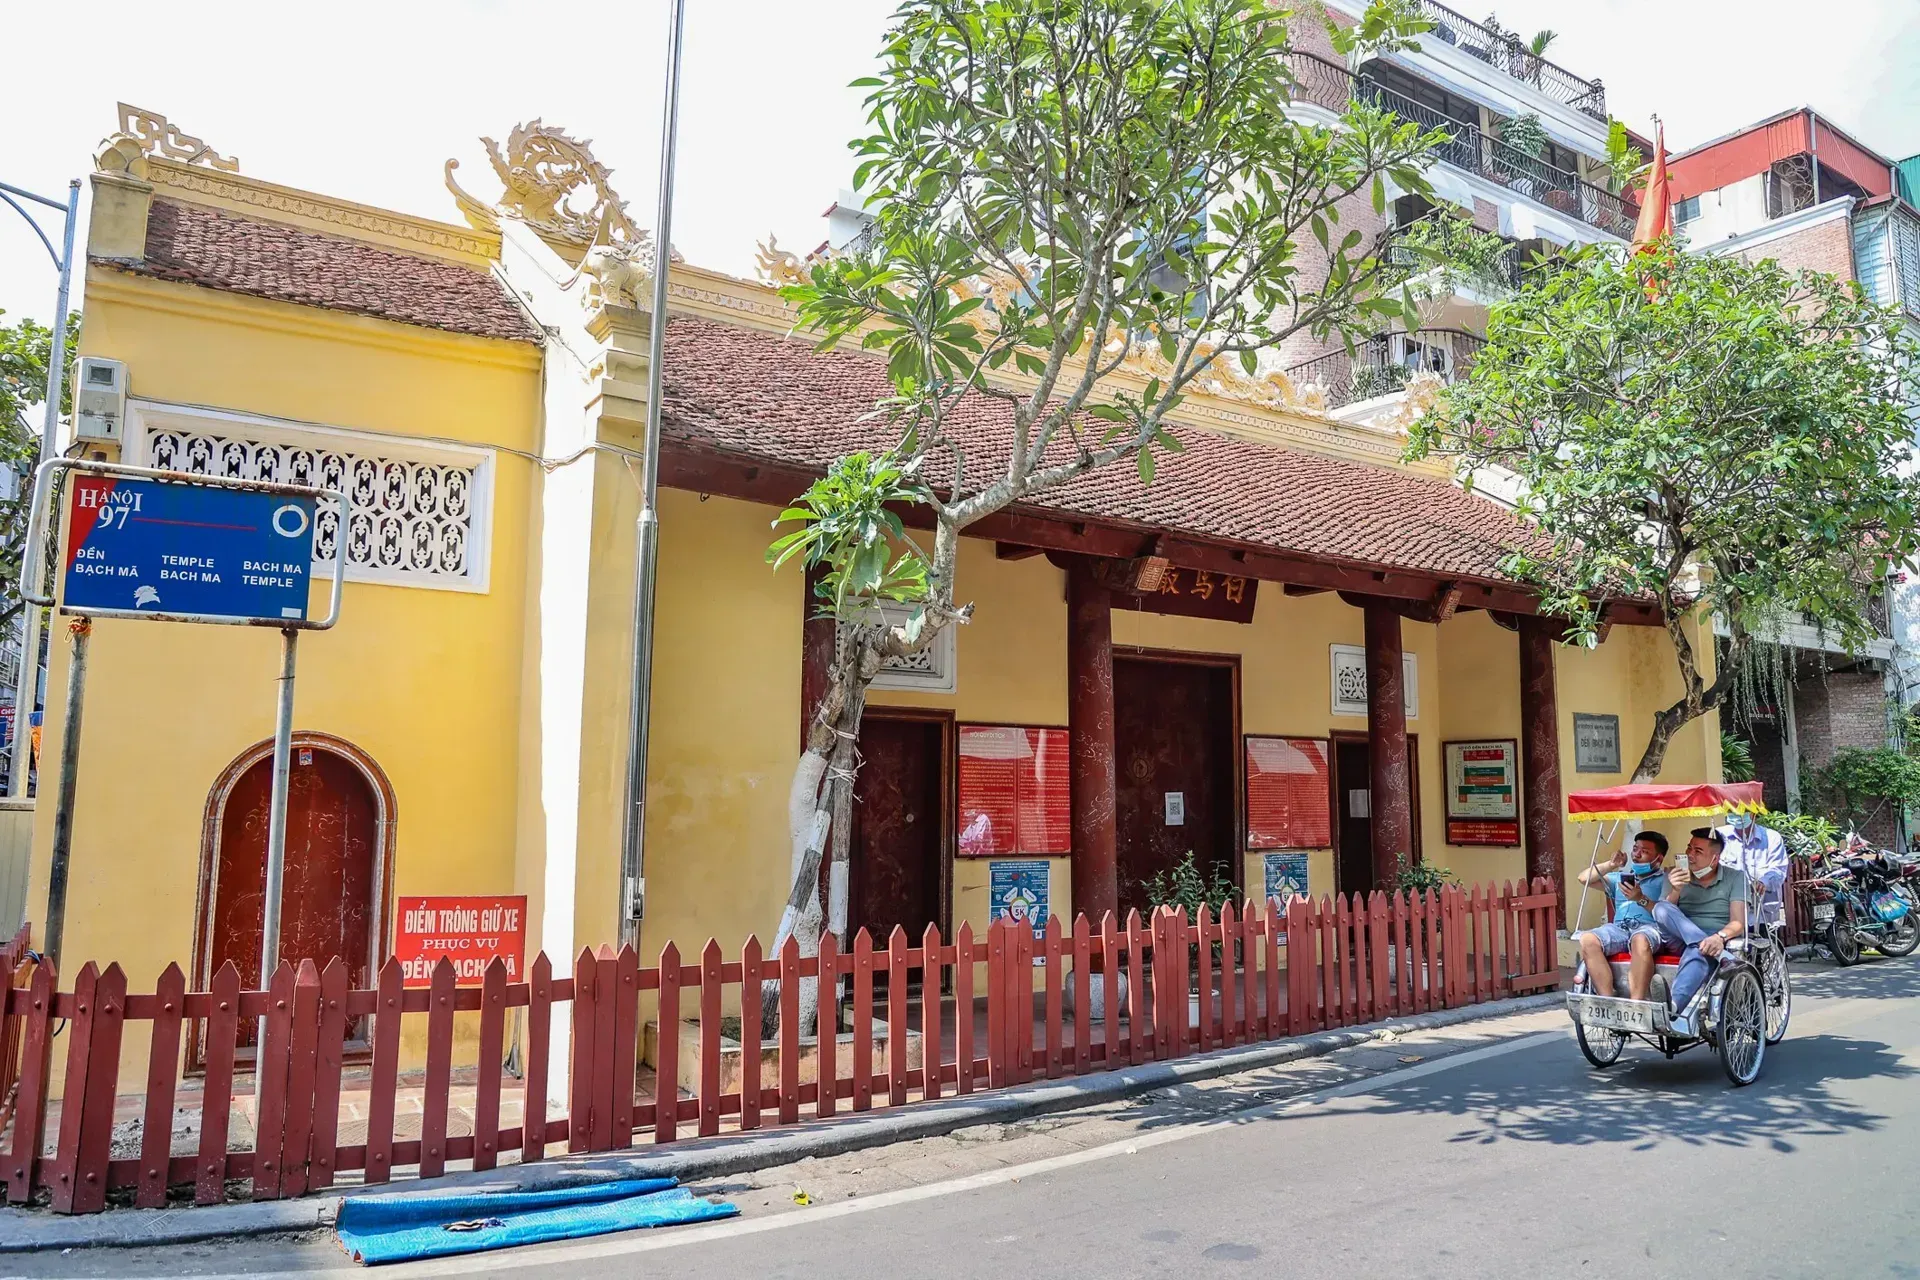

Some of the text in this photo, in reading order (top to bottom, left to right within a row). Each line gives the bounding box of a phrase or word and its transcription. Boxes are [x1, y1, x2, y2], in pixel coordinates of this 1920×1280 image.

[97, 505, 130, 530] 97
[161, 555, 215, 568] TEMPLE
[243, 560, 302, 574] BACH MA
[75, 563, 139, 577] BẠCH MÃ
[160, 569, 221, 583] BACH MA
[242, 575, 293, 588] TEMPLE
[404, 900, 519, 934] ĐIỂM TRÔNG GIỮ XE
[1015, 908, 1025, 916] 5K
[422, 938, 499, 951] PHỤC VỤ
[454, 958, 485, 982] ẠCH
[1588, 1006, 1644, 1024] 29XL-0047
